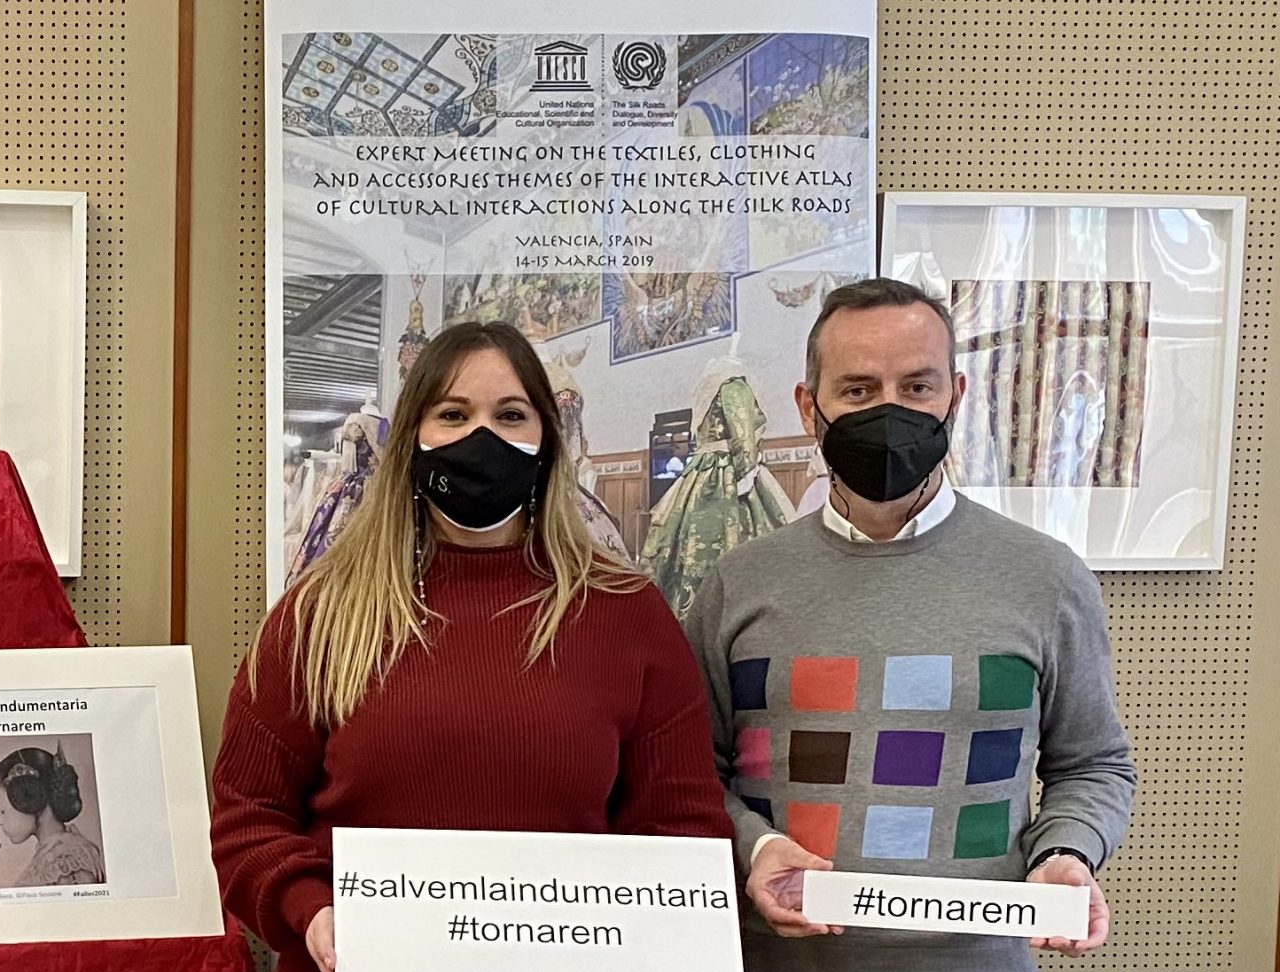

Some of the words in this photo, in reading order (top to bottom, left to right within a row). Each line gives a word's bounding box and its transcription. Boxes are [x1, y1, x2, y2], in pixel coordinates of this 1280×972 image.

[537, 56, 586, 81] UNESCO
[544, 110, 579, 118] Scientific
[647, 110, 679, 120] Diversity
[515, 119, 545, 127] Cultural
[546, 119, 595, 129] Organization
[628, 120, 674, 128] Development
[356, 145, 427, 161] EXPERT
[433, 145, 528, 162] MEETING
[535, 145, 564, 161] ON
[570, 145, 606, 161] THE
[612, 145, 702, 162] TEXTILES,
[710, 144, 816, 160] CLOTHING
[313, 172, 359, 188] AND
[366, 172, 490, 188] ACCESSORIES
[495, 171, 573, 188] THEMES
[580, 172, 605, 188] OF
[611, 172, 647, 188] THE
[655, 171, 789, 187] INTERACTIVE
[795, 171, 853, 188] ATLAS
[316, 200, 342, 216] OF
[349, 200, 459, 216] CULTURAL
[466, 199, 615, 216] INTERACTIONS
[621, 199, 691, 215] ALONG
[698, 199, 736, 214] THE
[743, 197, 784, 214] SILK
[791, 197, 852, 214] ROADS
[515, 235, 603, 248] VALENCIA,
[608, 234, 653, 247] SPAIN
[516, 255, 549, 268] 14-15
[554, 254, 617, 267] MARCH
[622, 255, 654, 267] 2019
[428, 470, 452, 494] I.S.
[338, 872, 730, 909] #salvemlaindumentaria
[853, 886, 1036, 926] #tornarem
[448, 915, 622, 946] #tornarem
